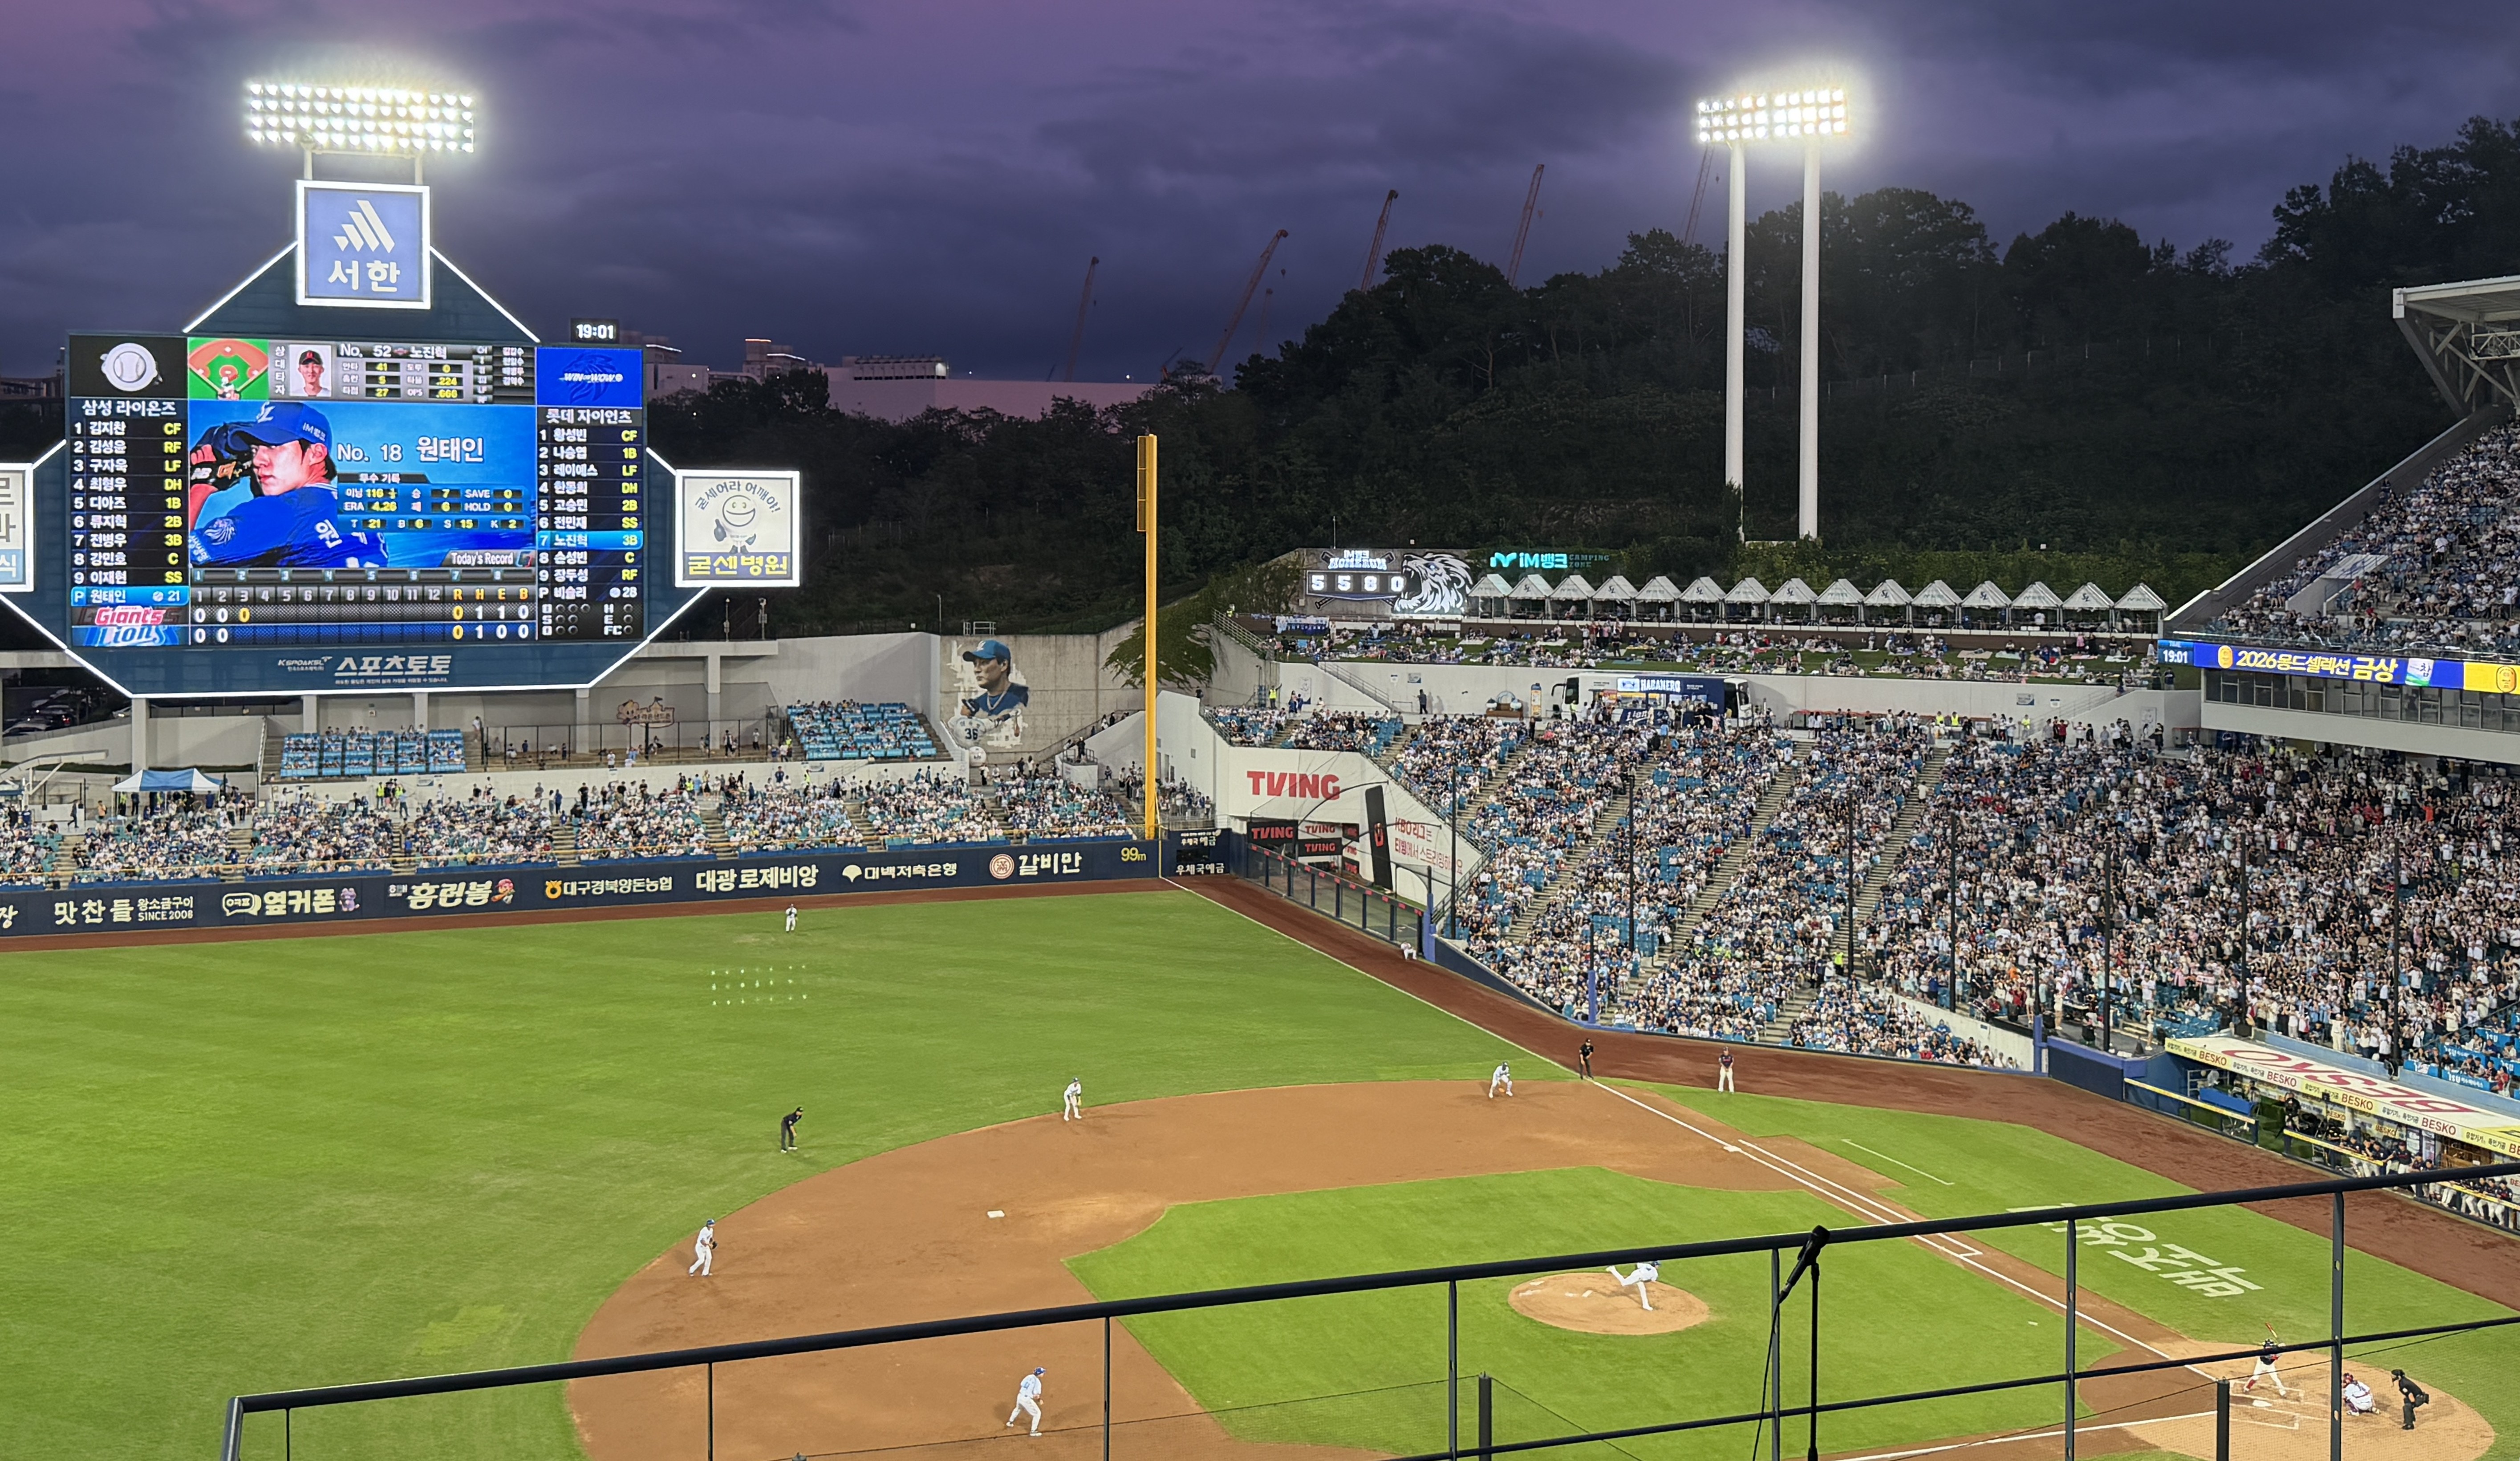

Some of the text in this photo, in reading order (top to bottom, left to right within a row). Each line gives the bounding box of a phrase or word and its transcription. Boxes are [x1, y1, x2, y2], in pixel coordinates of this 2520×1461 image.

[328, 260, 401, 293] 서한
[576, 324, 614, 339] 19:01
[340, 343, 447, 359] No. 52 노진혁
[375, 362, 388, 371] 41
[376, 388, 389, 397] 27
[82, 399, 177, 417] 삼성 라이온즈
[546, 408, 633, 425] 롯데 자이언츠
[89, 421, 182, 436] 김지찬 CF
[621, 430, 638, 442] CF
[74, 441, 84, 453] 2
[164, 441, 182, 453] RF
[337, 436, 484, 463] No. 18 원태인
[623, 447, 637, 459] 1B
[74, 459, 182, 473] 3 구자욱 LF
[539, 464, 549, 476] 3
[622, 464, 638, 476] LF
[73, 478, 84, 490] 4
[164, 478, 182, 490] DH
[539, 481, 638, 494] 4 DH
[464, 489, 491, 499] SAVE
[694, 480, 782, 513] 굳세어라 어깨야!
[74, 496, 182, 510] 5 디아즈 1B
[343, 501, 398, 512] ERA 4.26
[464, 502, 491, 512] HOLD
[553, 498, 638, 512] 고승민 2B
[74, 515, 84, 529] 6
[164, 515, 183, 528] 2B
[368, 519, 381, 529] 21
[459, 520, 474, 529] 15
[539, 516, 638, 529] 6 전민재 SS
[74, 533, 183, 548] 7 전병우 3B
[622, 535, 638, 546] 3B
[74, 552, 179, 566] 8 강민호 C
[451, 551, 513, 567] Today's Record
[539, 552, 549, 564] 8
[624, 552, 635, 564] C
[1519, 552, 1568, 569] iM뱅크
[1569, 553, 1610, 562] CAMPING
[688, 555, 787, 576] 굳센병원
[1569, 562, 1592, 570] ZONE
[74, 570, 183, 585] 9 이재현 SS
[539, 568, 638, 582] 9 장두성 RF
[74, 590, 180, 603] P 원태인 21
[386, 589, 440, 601] 10 11 12
[539, 586, 550, 599] P
[622, 586, 638, 598] 28
[96, 606, 166, 625] Giants
[194, 605, 529, 623] 0 0 0 0 1 1 0
[194, 624, 529, 643] 0 0 0 1 0 0
[603, 625, 623, 636] FC
[2163, 650, 2189, 664] 19:01
[334, 655, 452, 676] 스포츠토토
[2352, 656, 2399, 683] 금상
[1640, 679, 1681, 693] HABANERO
[964, 728, 978, 740] 36
[1247, 770, 1340, 801] TVING
[1251, 826, 1294, 839] TVING
[1305, 824, 1335, 834] TVING
[1120, 846, 1147, 862] 99m
[1305, 842, 1336, 853] TVING
[1019, 852, 1082, 876] 갈비만
[1420, 847, 1463, 875] 스트리밍하요
[864, 862, 957, 880] 대백저축은행
[1176, 863, 1225, 875] 우체국예금
[696, 864, 819, 892] 대광 로제비앙
[563, 875, 672, 896] 대구경북양돈농협
[406, 879, 493, 910] 홈런볼
[137, 895, 194, 912] 왕소금구이
[138, 909, 194, 922] SINCE 2008
[2198, 1049, 2227, 1066] BESKO
[2267, 1070, 2297, 1087] BESKO
[2341, 1093, 2374, 1111] BESKO
[2421, 1116, 2456, 1136] BESKO
